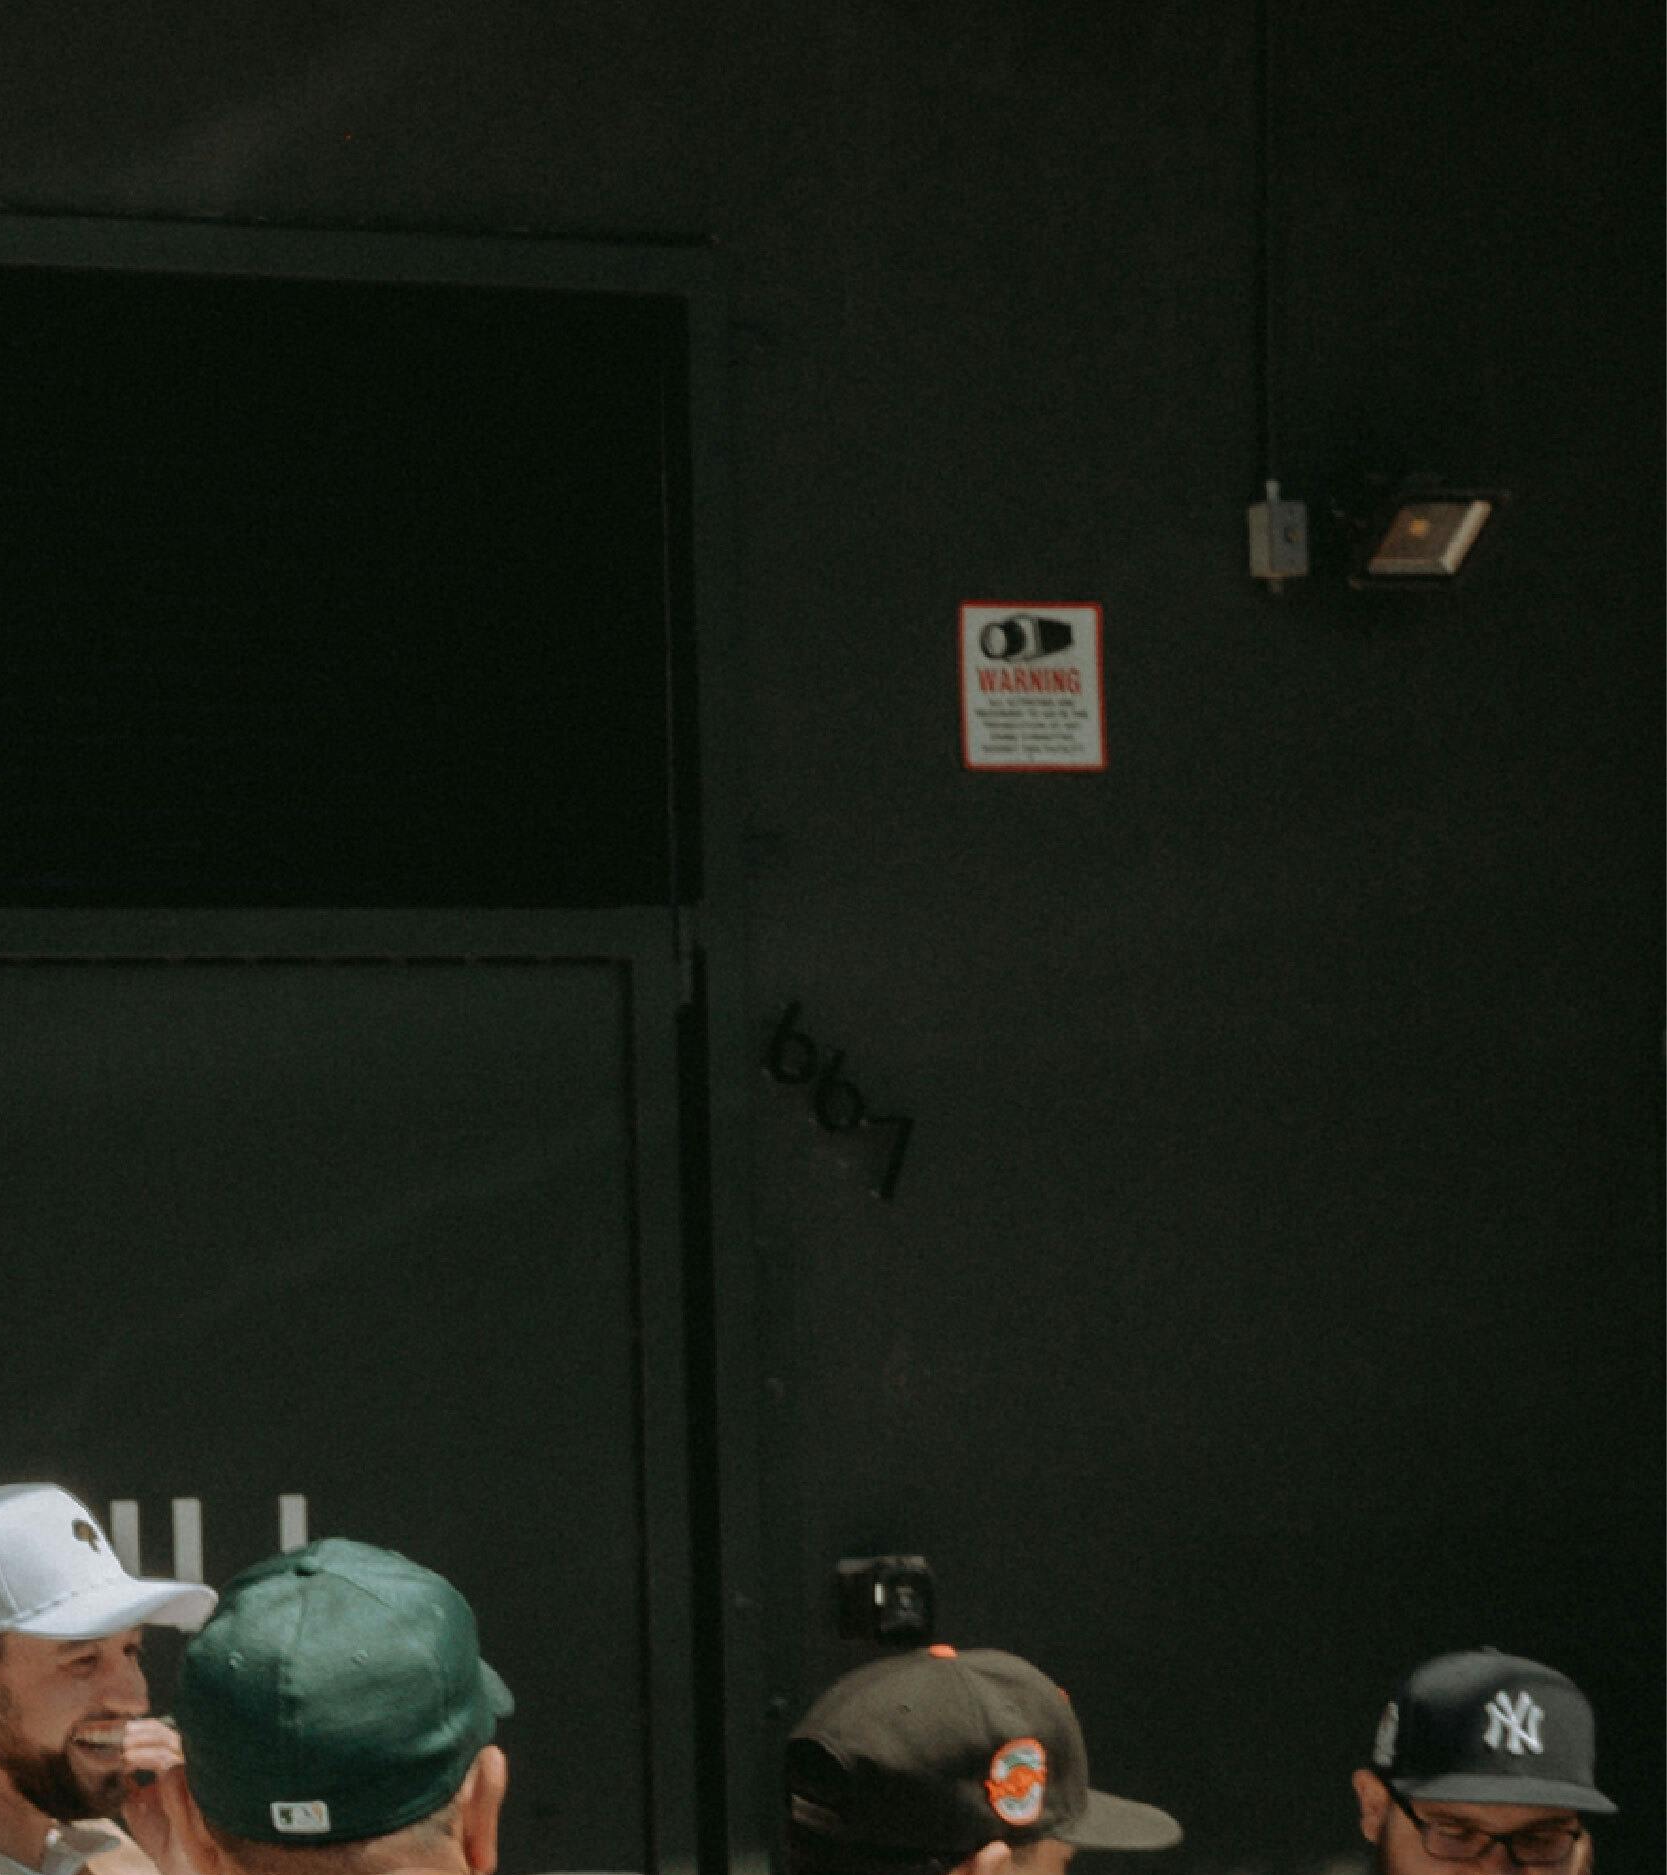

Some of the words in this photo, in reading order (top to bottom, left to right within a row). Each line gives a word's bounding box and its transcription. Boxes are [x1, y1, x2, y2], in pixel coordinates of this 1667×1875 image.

[978, 667, 1082, 694] WARNING
[762, 1000, 915, 1200] 667
[1483, 1690, 1546, 1755] NY
